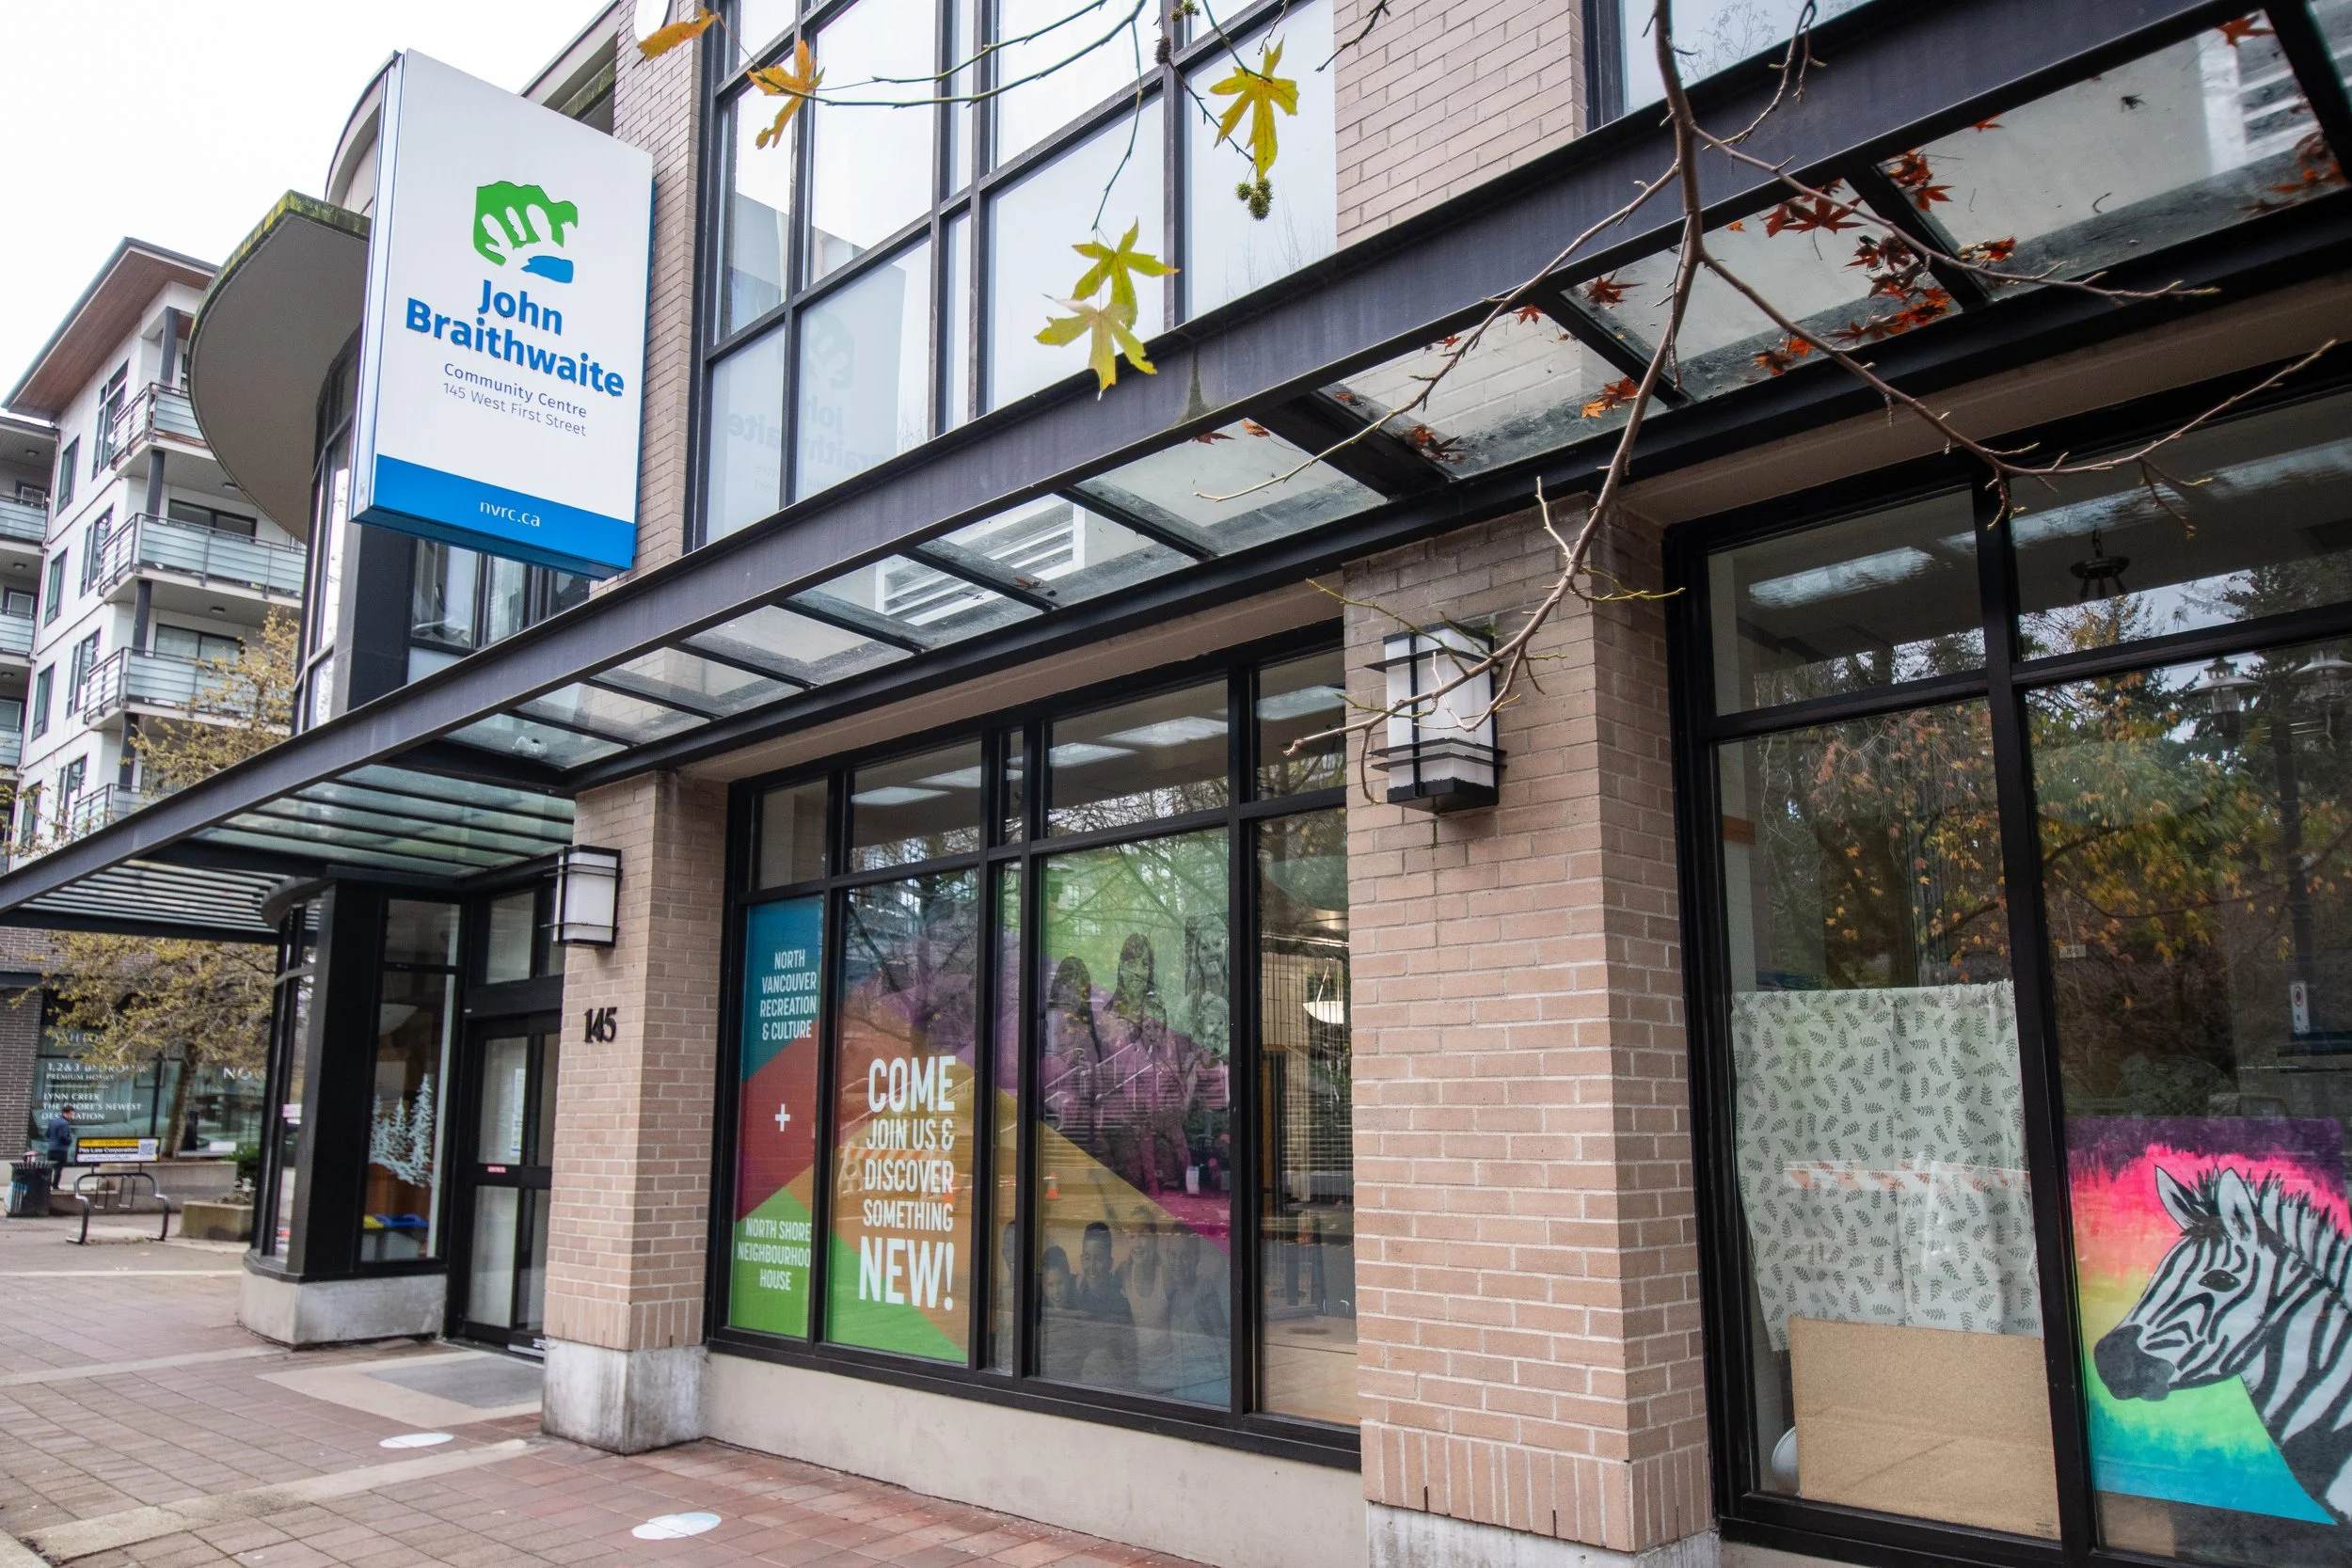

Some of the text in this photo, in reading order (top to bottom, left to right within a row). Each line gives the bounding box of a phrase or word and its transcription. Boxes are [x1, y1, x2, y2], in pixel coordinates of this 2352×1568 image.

[477, 279, 563, 336] John
[405, 297, 625, 397] Braithwaite
[444, 363, 587, 419] Community Centre
[443, 383, 587, 436] 145 West First Street
[480, 501, 541, 528] nvrc.ca
[774, 949, 806, 970] NORTH
[761, 972, 818, 994] VANCOUVER
[759, 995, 817, 1018] RECREATION
[583, 1006, 618, 1043] 145
[762, 1020, 813, 1040] & CULTURE
[43, 1092, 101, 1101] LYNN CREEK
[868, 1055, 956, 1113] COME
[42, 1102, 61, 1111] THE
[105, 1102, 143, 1111] NEWEST
[866, 1118, 955, 1151] JOIN US &
[864, 1158, 955, 1194] DISCOVER
[745, 1217, 812, 1242] NORTH SHORE
[863, 1198, 954, 1232] SOMETHING
[738, 1242, 812, 1268] NEIGHBOURHOO
[759, 1268, 792, 1291] HOUSE
[859, 1235, 955, 1311] NEW!
